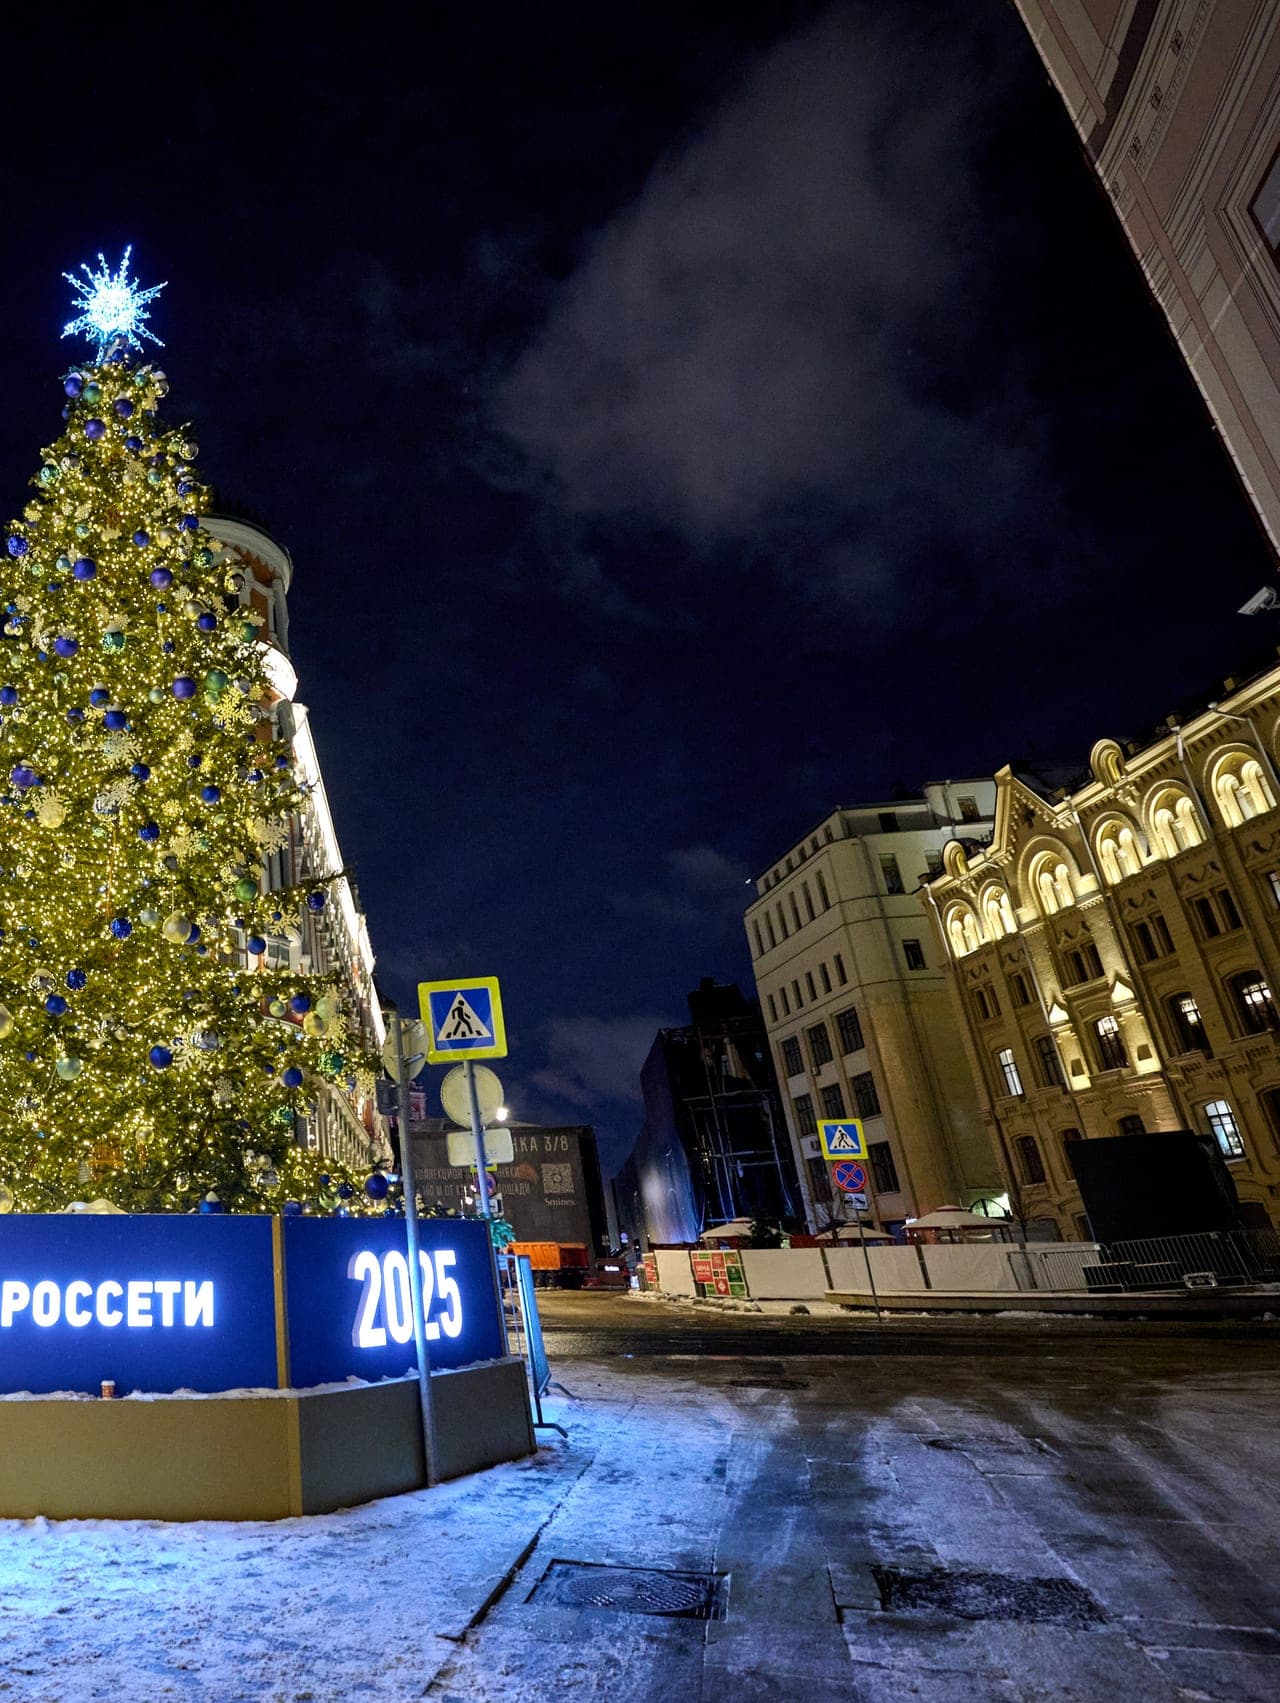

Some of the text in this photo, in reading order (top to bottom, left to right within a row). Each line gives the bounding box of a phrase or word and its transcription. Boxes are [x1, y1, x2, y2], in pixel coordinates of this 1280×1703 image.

[543, 1135, 569, 1152] 3/8
[0, 1280, 214, 1328] РОССЕТИ
[351, 1250, 463, 1348] 2025
